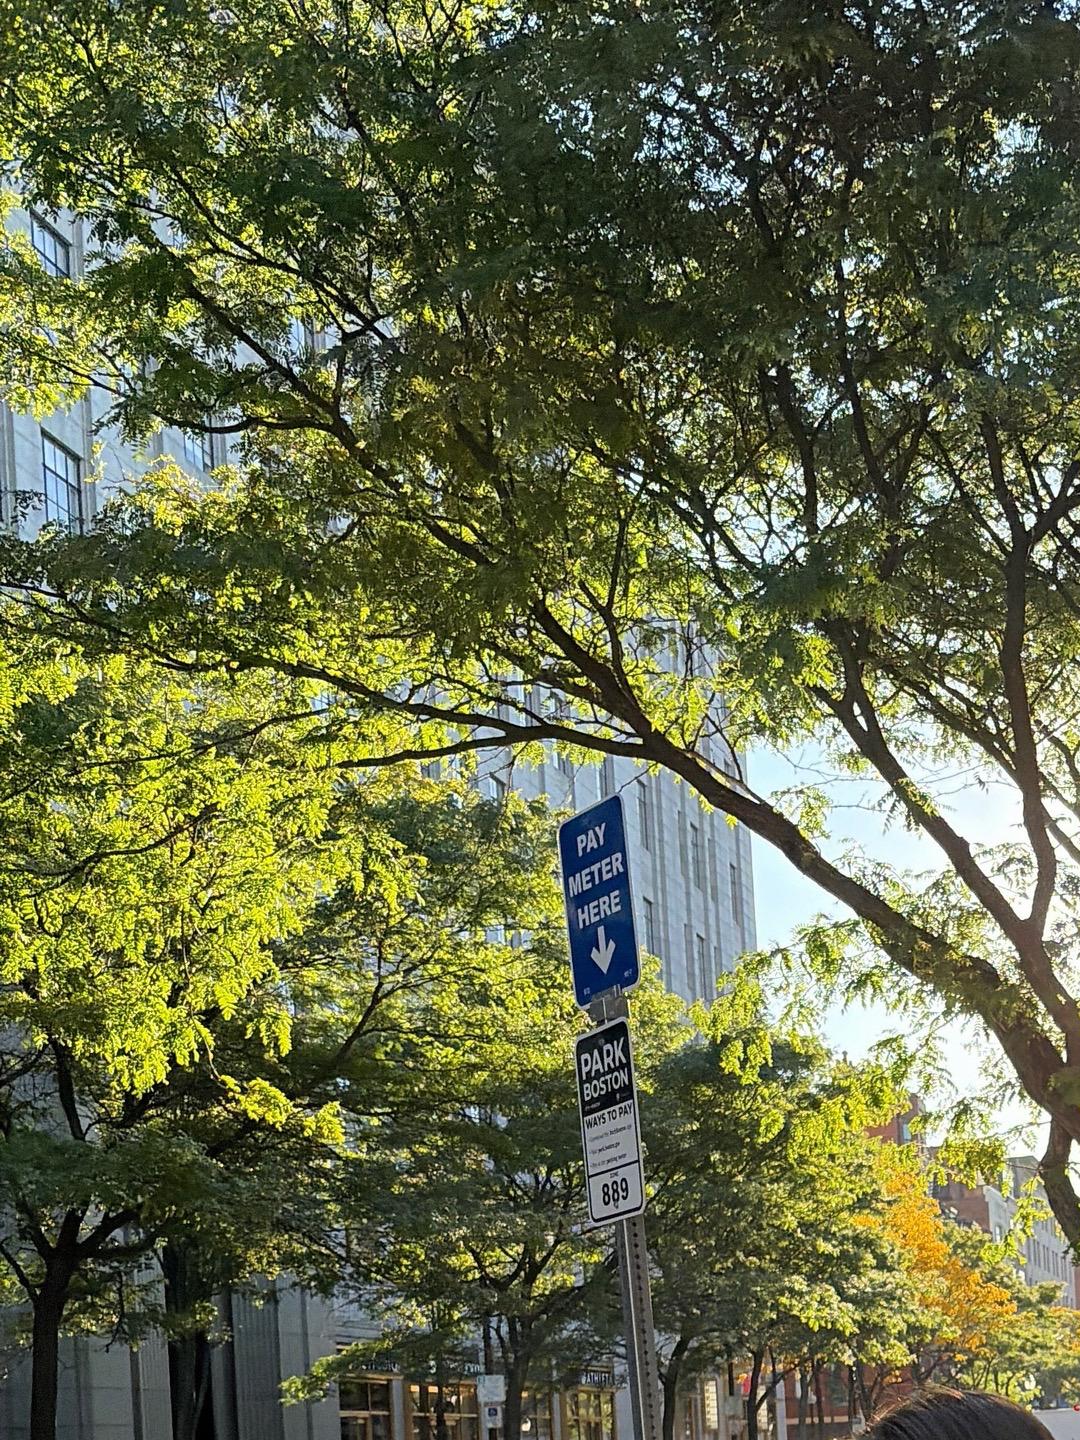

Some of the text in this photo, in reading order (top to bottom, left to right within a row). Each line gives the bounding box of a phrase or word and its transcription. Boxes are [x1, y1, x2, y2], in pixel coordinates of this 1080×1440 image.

[577, 822, 606, 857] PAY
[567, 852, 624, 898] METER
[577, 889, 622, 929] HERE
[580, 1036, 627, 1080] PARK
[583, 1067, 629, 1101] BOSTON
[585, 1112, 607, 1130] WAYS
[607, 1109, 617, 1122] TO
[618, 1102, 633, 1118] PAY
[601, 1177, 629, 1207] 889
